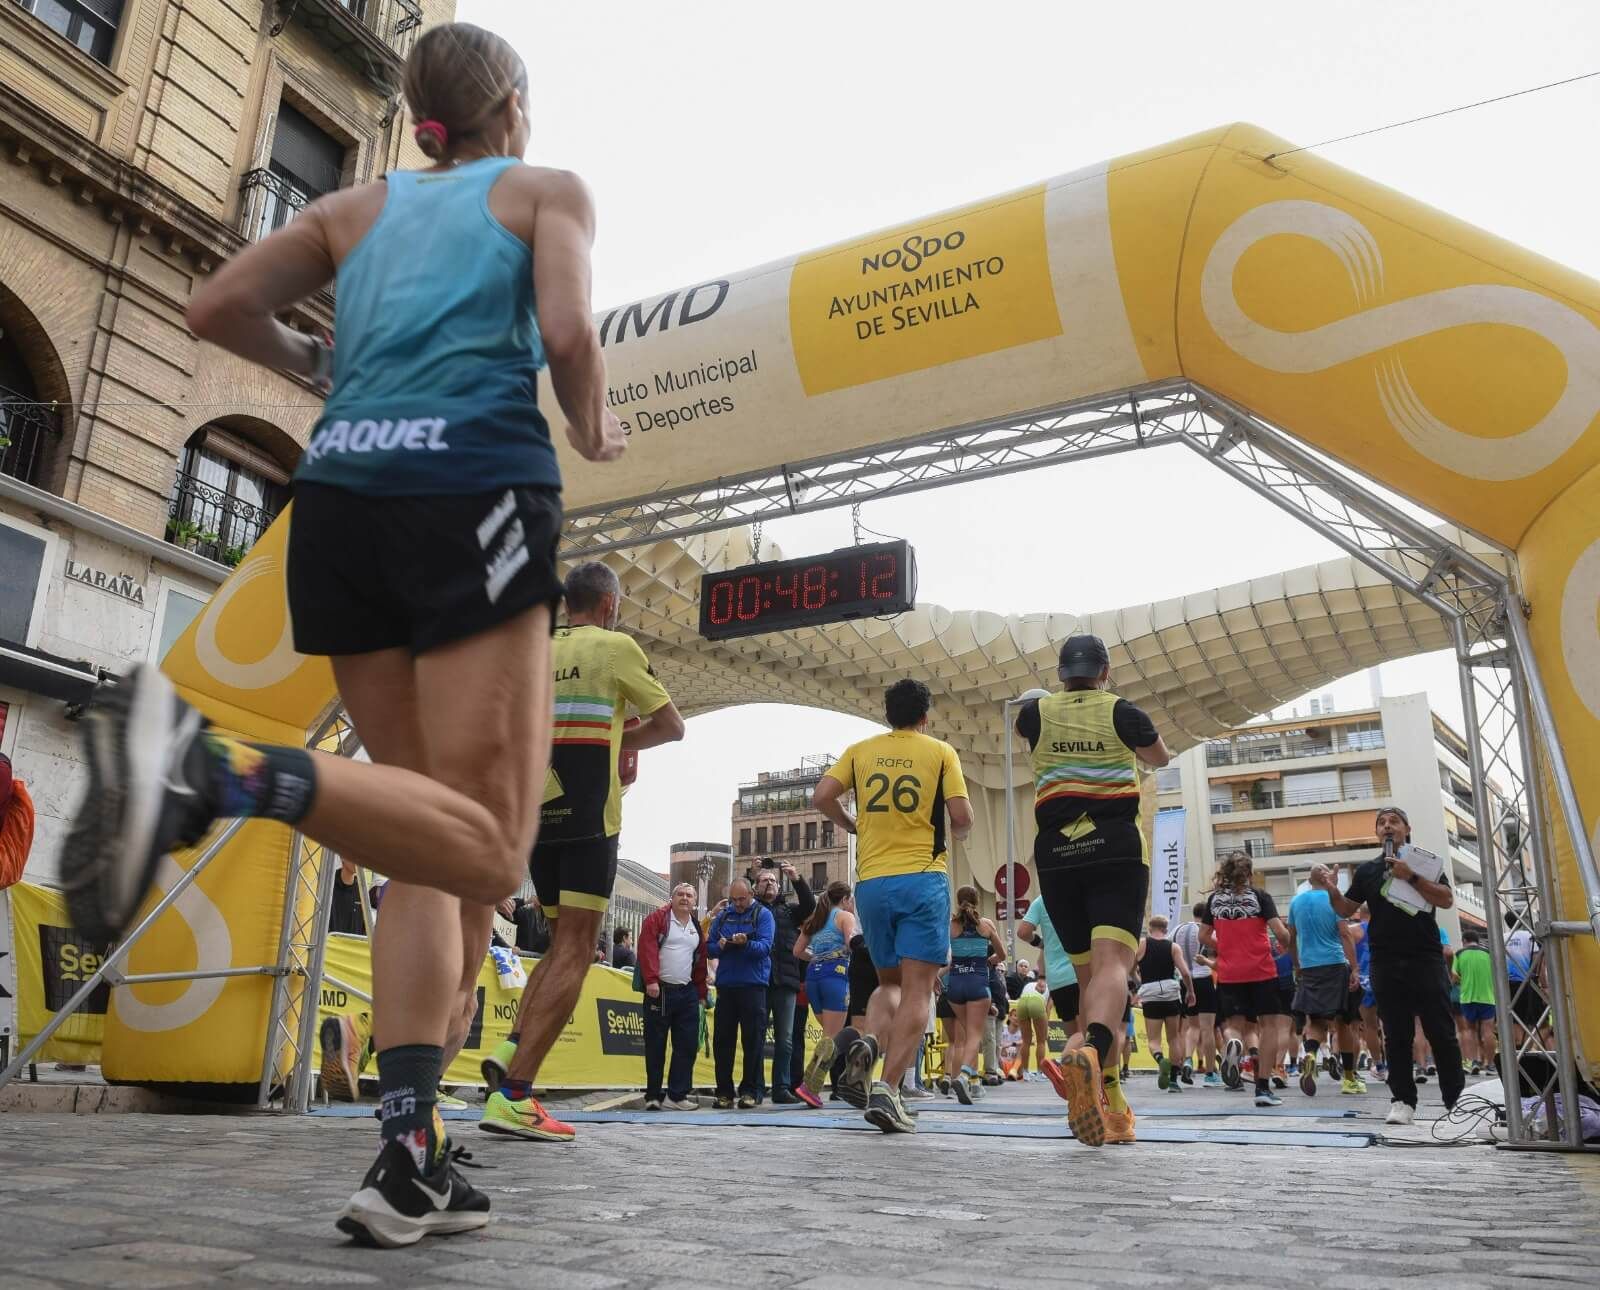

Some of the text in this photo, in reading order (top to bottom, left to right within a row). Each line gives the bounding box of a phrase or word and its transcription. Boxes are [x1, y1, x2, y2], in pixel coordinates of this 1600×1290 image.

[828, 256, 1004, 319] AYUNTAMIENTO
[600, 280, 730, 347] IMD
[856, 292, 980, 340] DE SEVILLA
[654, 350, 758, 395] Municipal
[636, 396, 734, 432] Deportes
[67, 561, 144, 602] LARAÑA
[1052, 741, 1105, 753] SEVILLA
[866, 773, 922, 814] 26
